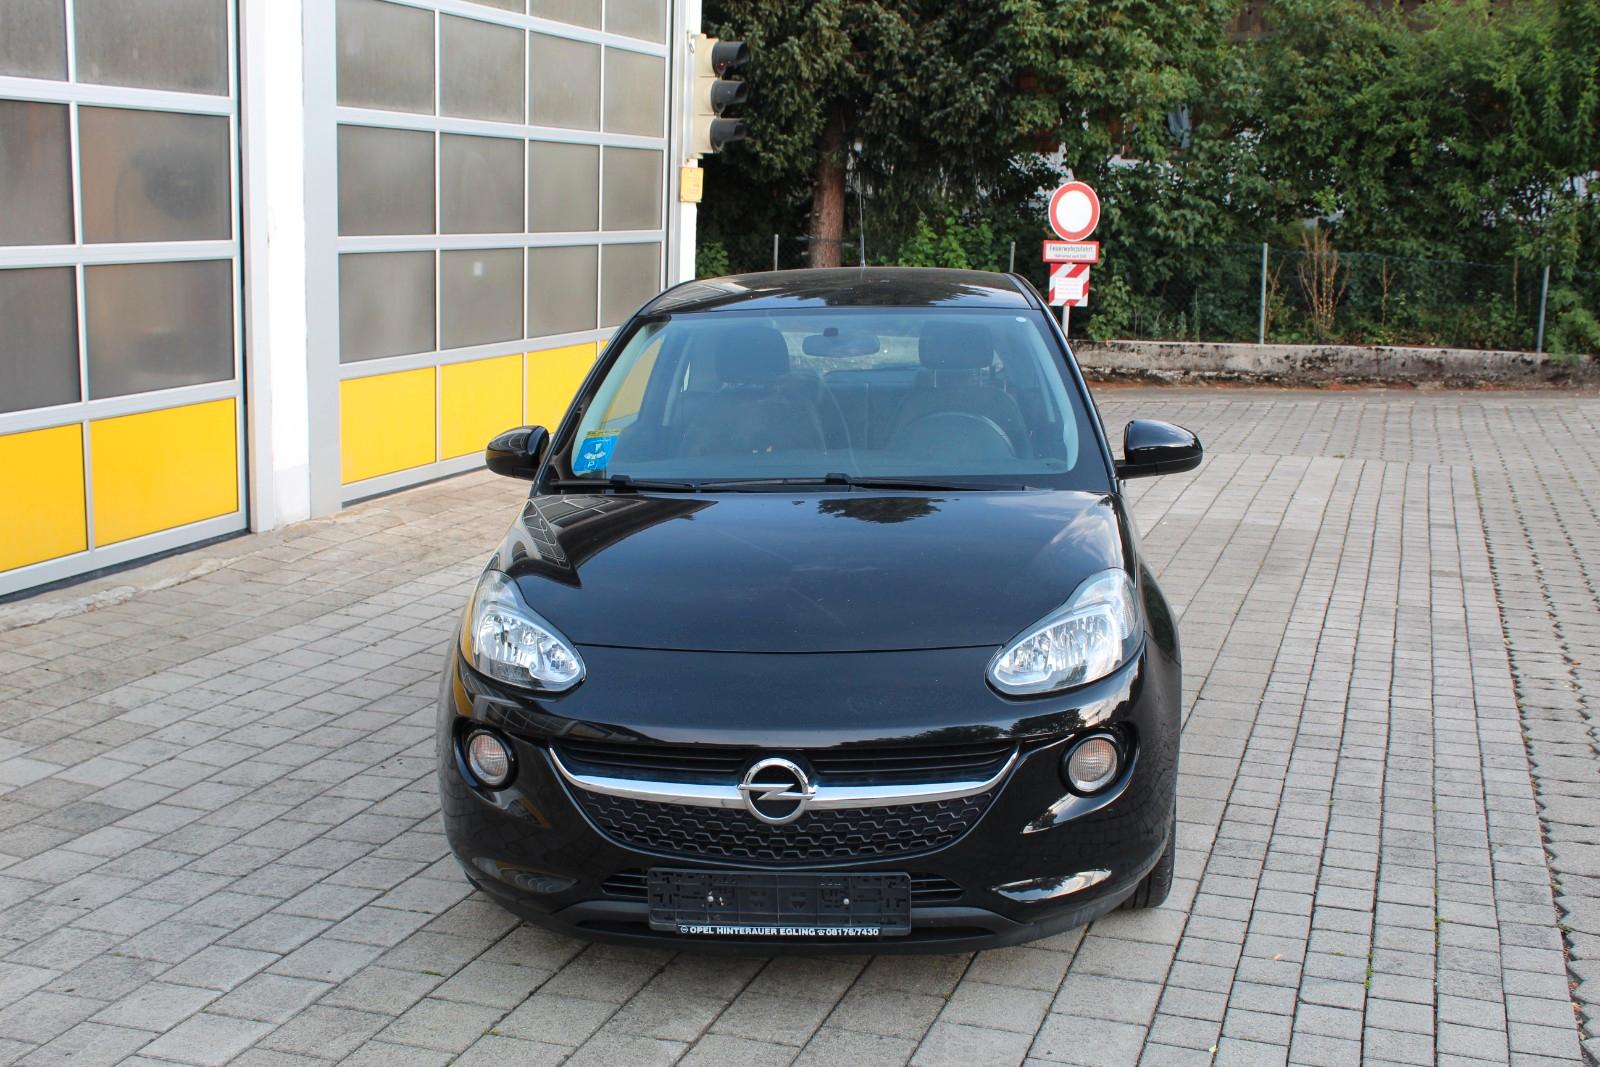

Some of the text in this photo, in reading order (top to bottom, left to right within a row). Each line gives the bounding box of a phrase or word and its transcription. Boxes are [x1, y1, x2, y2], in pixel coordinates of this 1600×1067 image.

[690, 926, 714, 934] OPEL
[716, 926, 777, 935] HINTERAUER
[779, 927, 816, 936] EGLING
